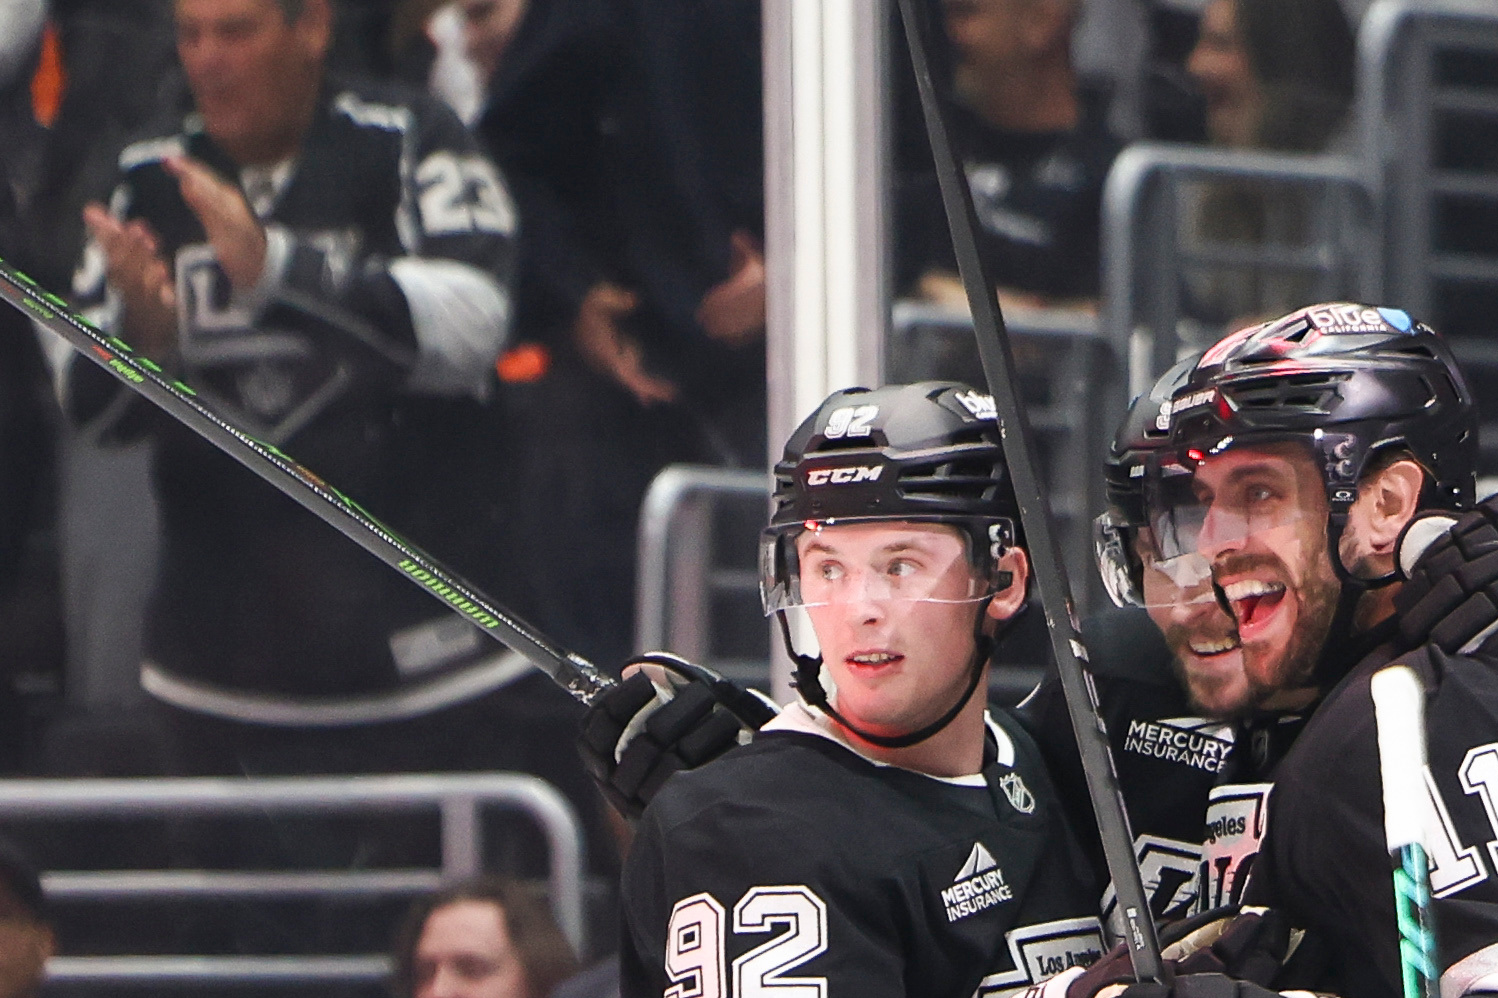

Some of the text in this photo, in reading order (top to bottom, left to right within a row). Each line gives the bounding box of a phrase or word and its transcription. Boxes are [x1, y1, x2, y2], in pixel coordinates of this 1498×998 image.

[416, 152, 517, 236] 23
[1308, 307, 1381, 328] blue
[823, 404, 880, 439] 92
[807, 465, 884, 486] CCM
[1128, 720, 1234, 759] MERCURY
[940, 869, 1005, 908] MERCURY
[946, 885, 1014, 922] INSURANCE
